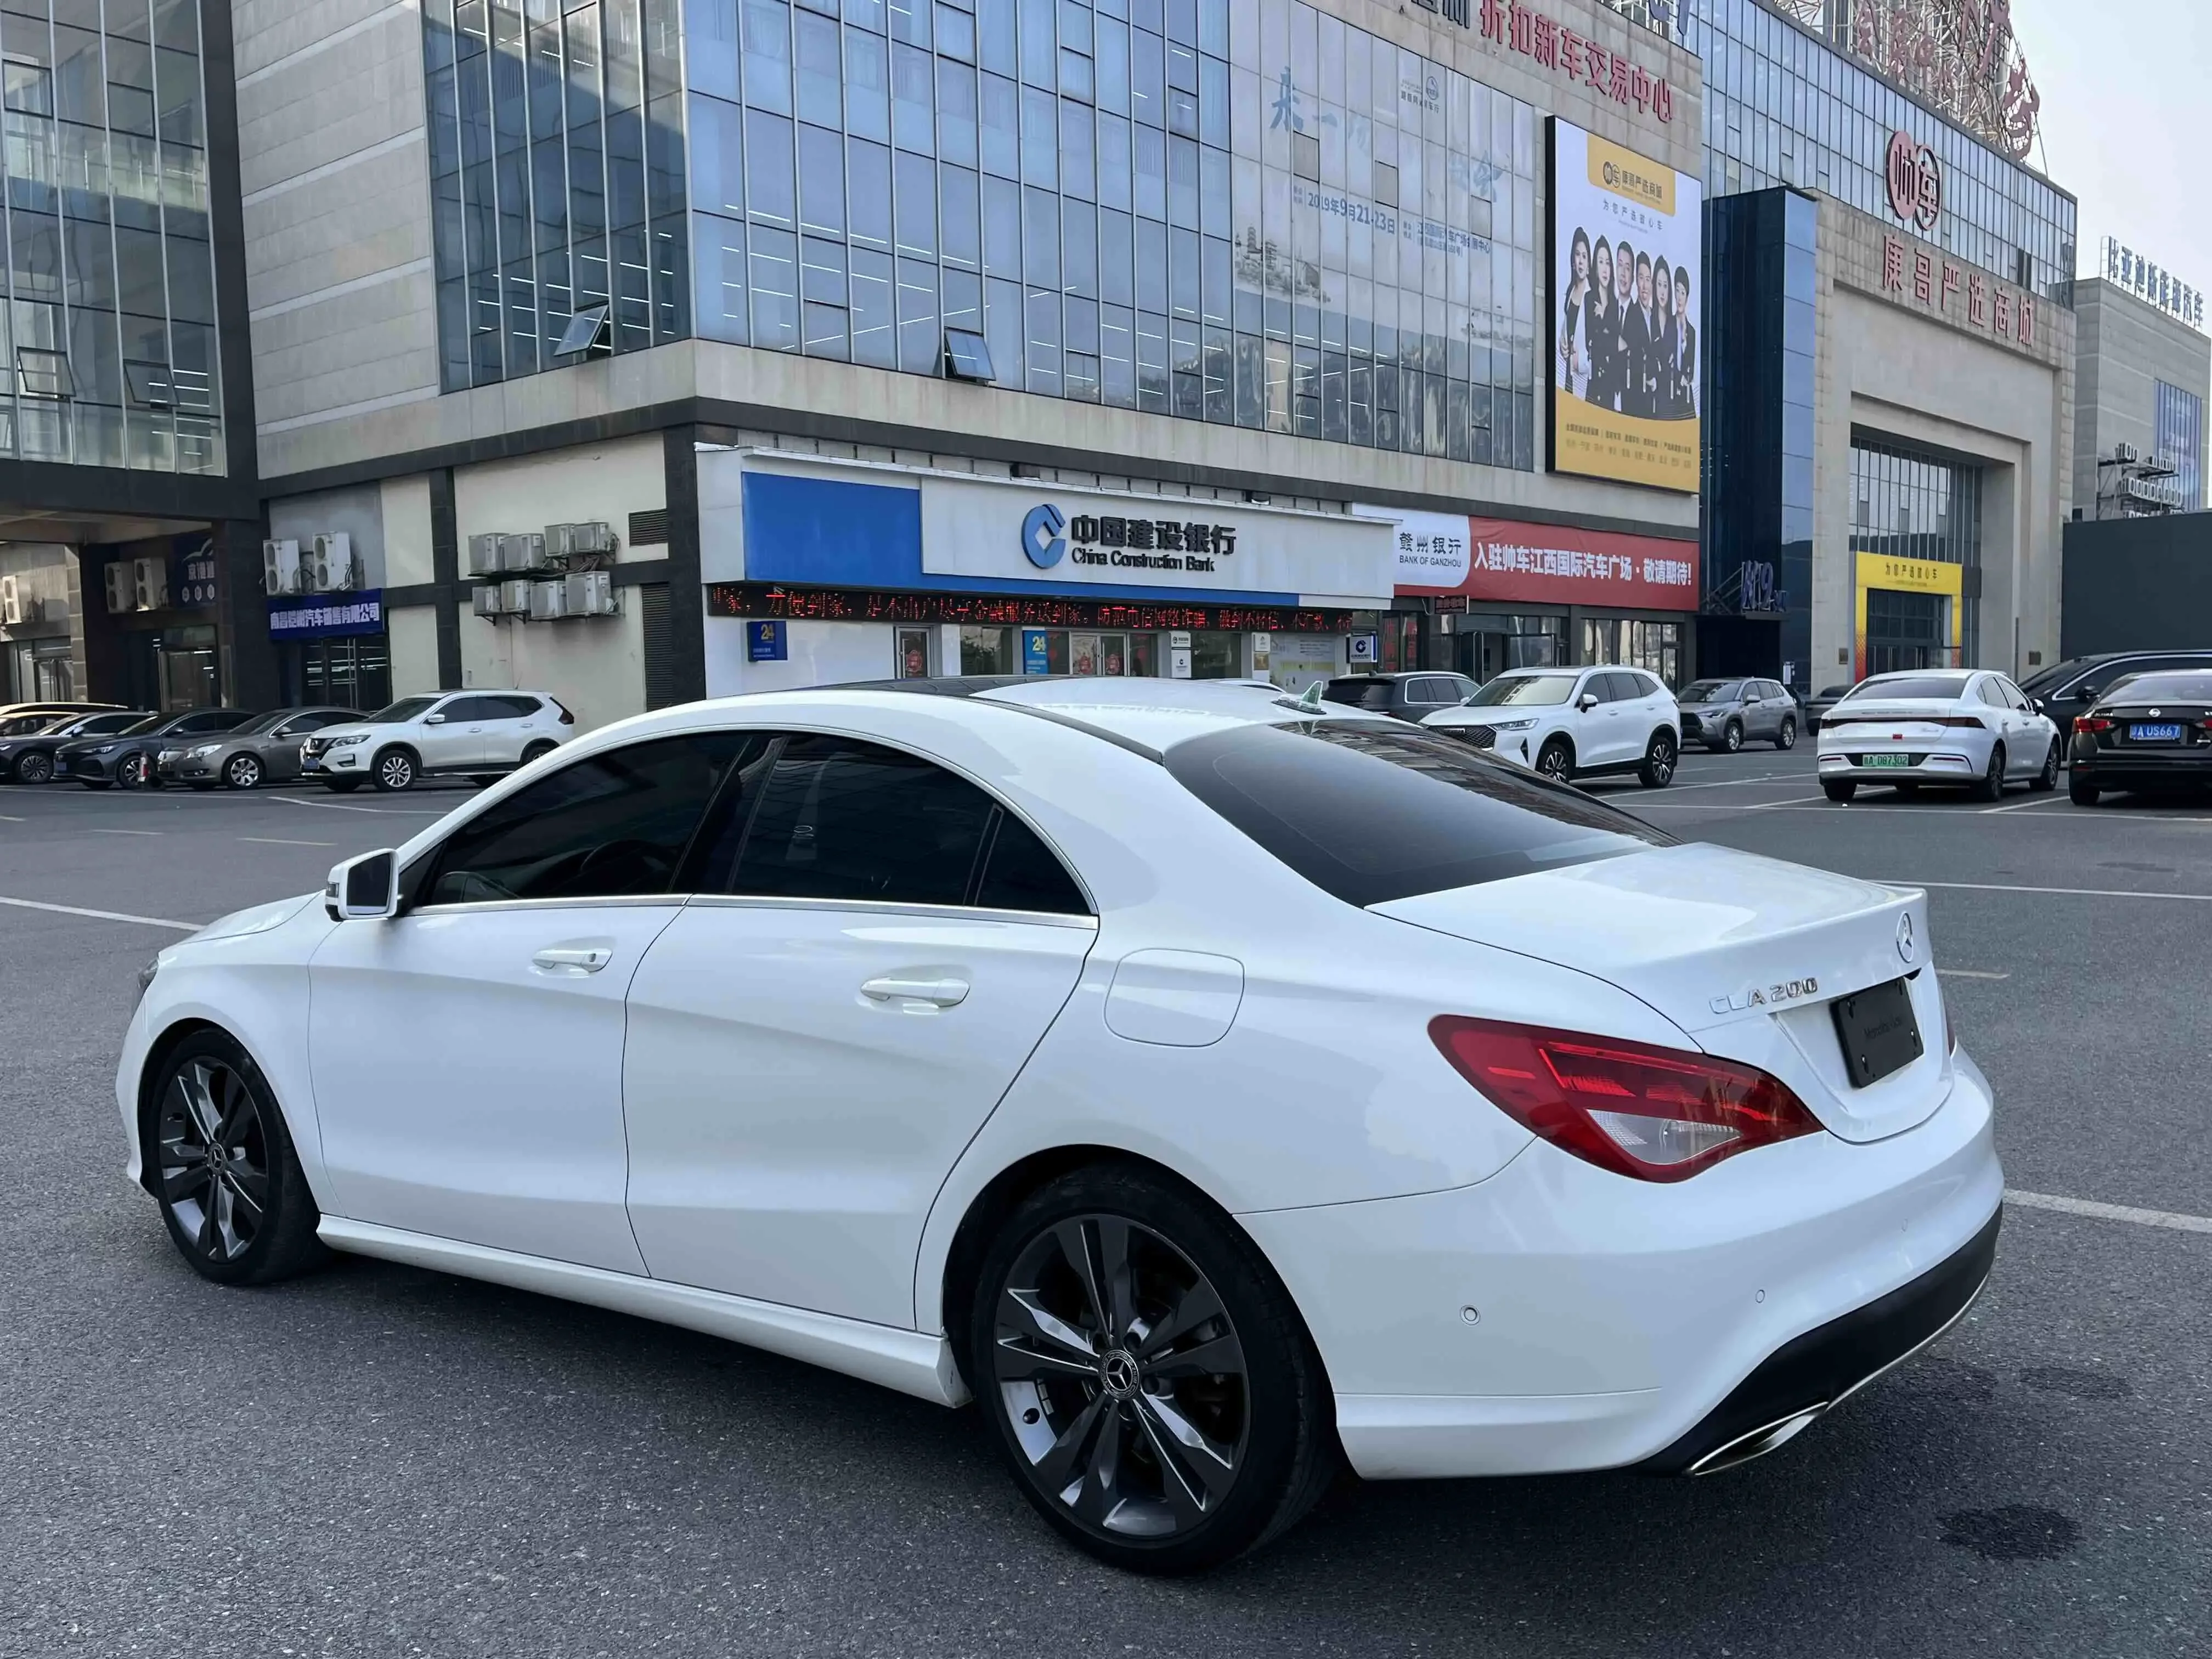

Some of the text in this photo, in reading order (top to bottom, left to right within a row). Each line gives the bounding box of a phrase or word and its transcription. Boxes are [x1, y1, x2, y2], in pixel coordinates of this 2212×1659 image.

[1480, 0, 1672, 123] 折扣新车交易中心
[1071, 515, 1236, 555] 中国建设银行
[1400, 532, 1462, 554] 赣州银行
[1072, 548, 1215, 572] China Construction Bank
[1400, 555, 1462, 568] BANK OF GANZHOU
[1032, 636, 1046, 652] 24
[1708, 977, 1818, 1014] CLA 200
